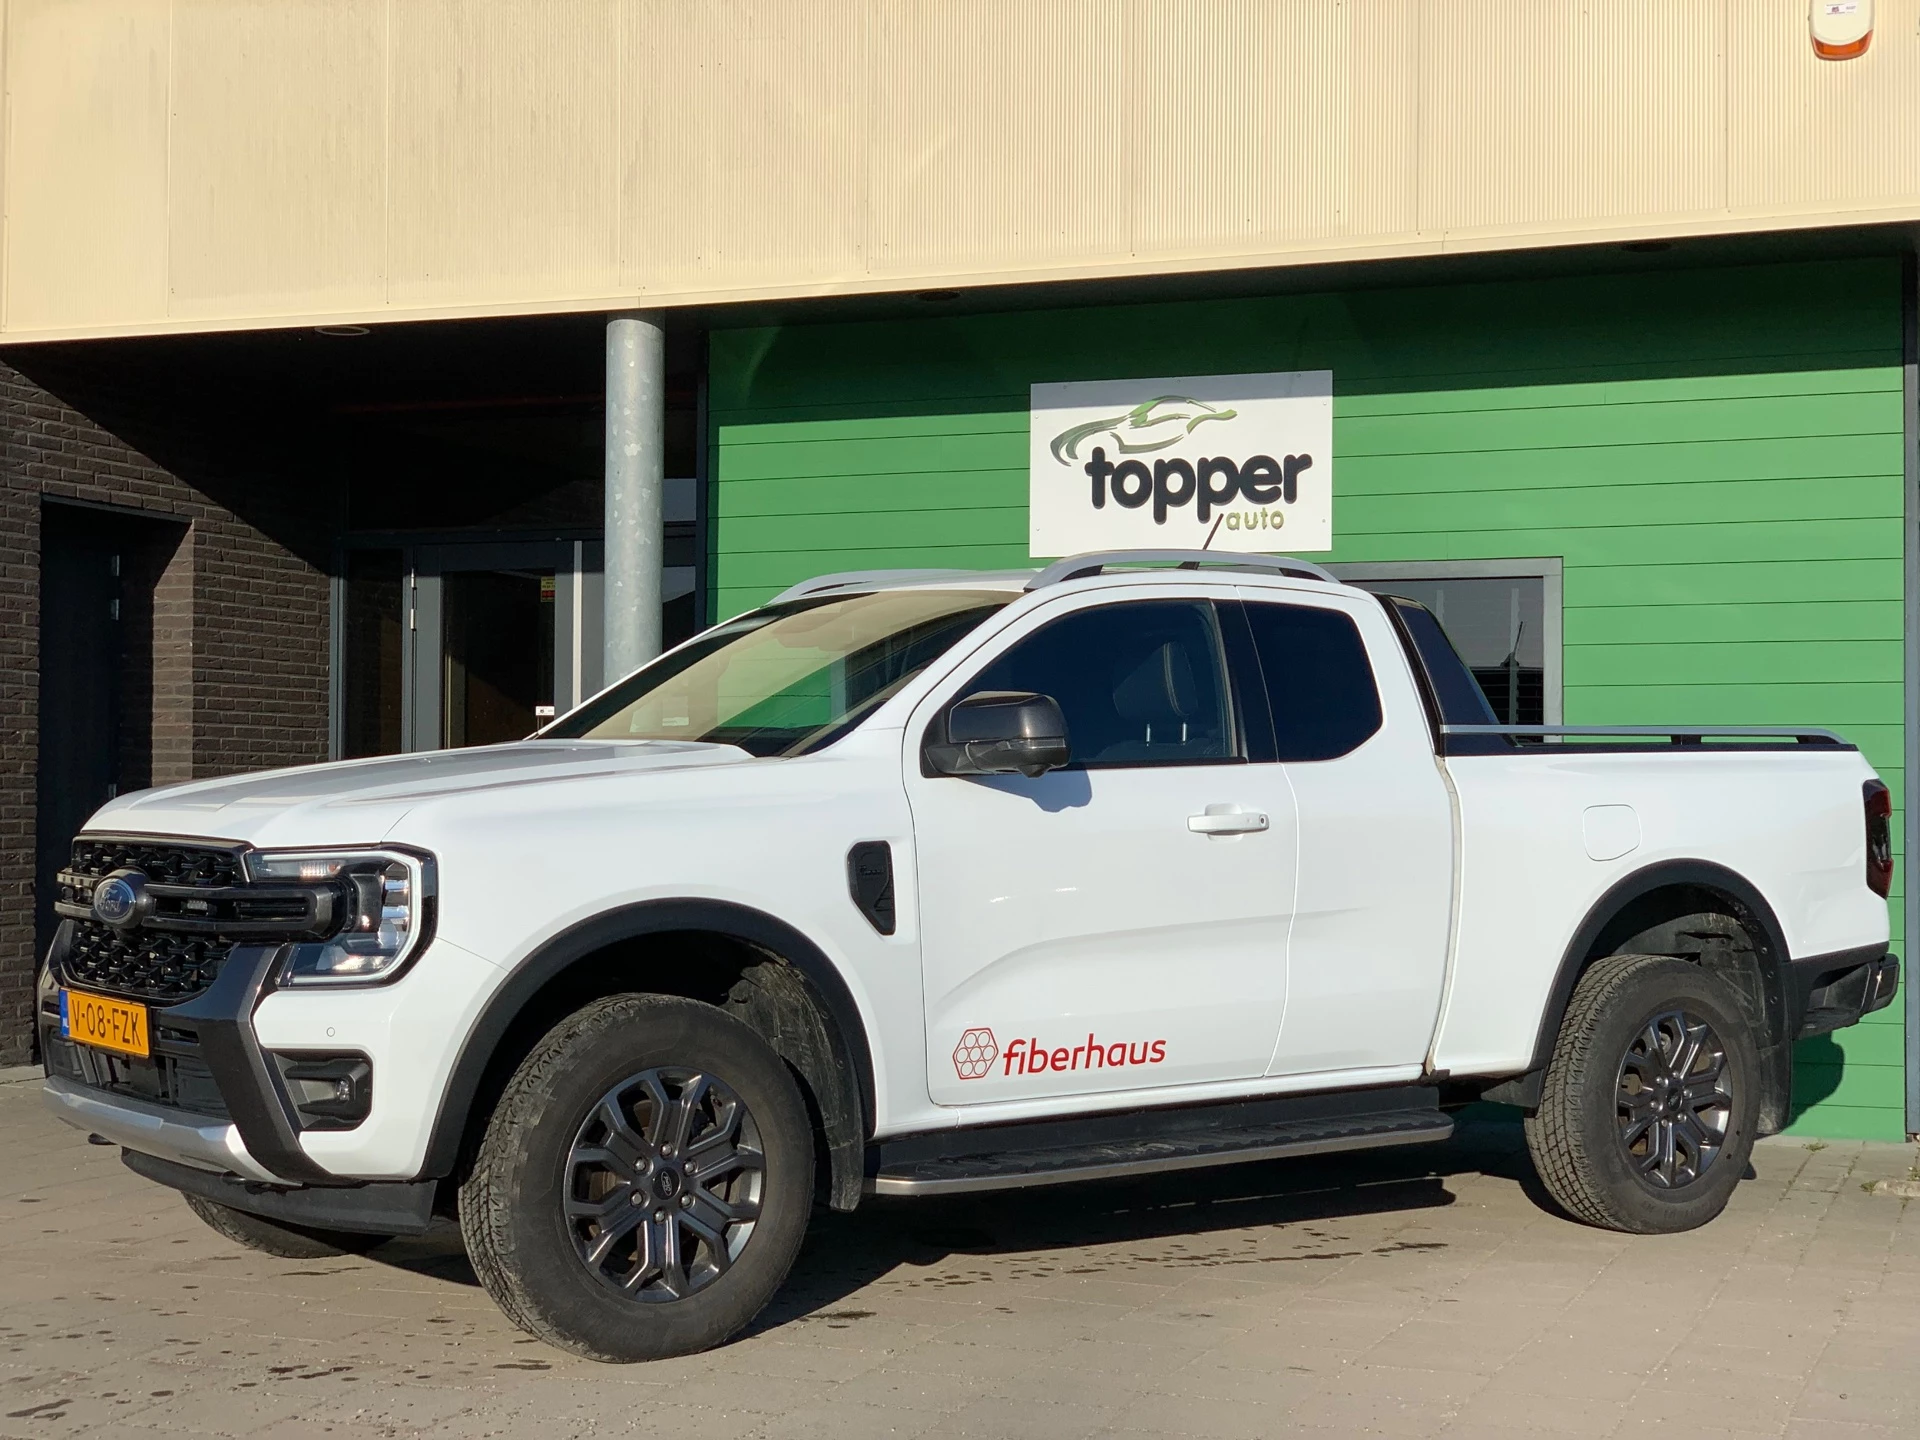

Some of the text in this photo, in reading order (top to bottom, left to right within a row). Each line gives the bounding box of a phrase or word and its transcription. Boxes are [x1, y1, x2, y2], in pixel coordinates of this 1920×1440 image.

[1084, 447, 1313, 525] topper
[1225, 507, 1285, 531] auto
[72, 999, 142, 1047] V-08-FZK
[1003, 1033, 1167, 1076] fiberhaus
